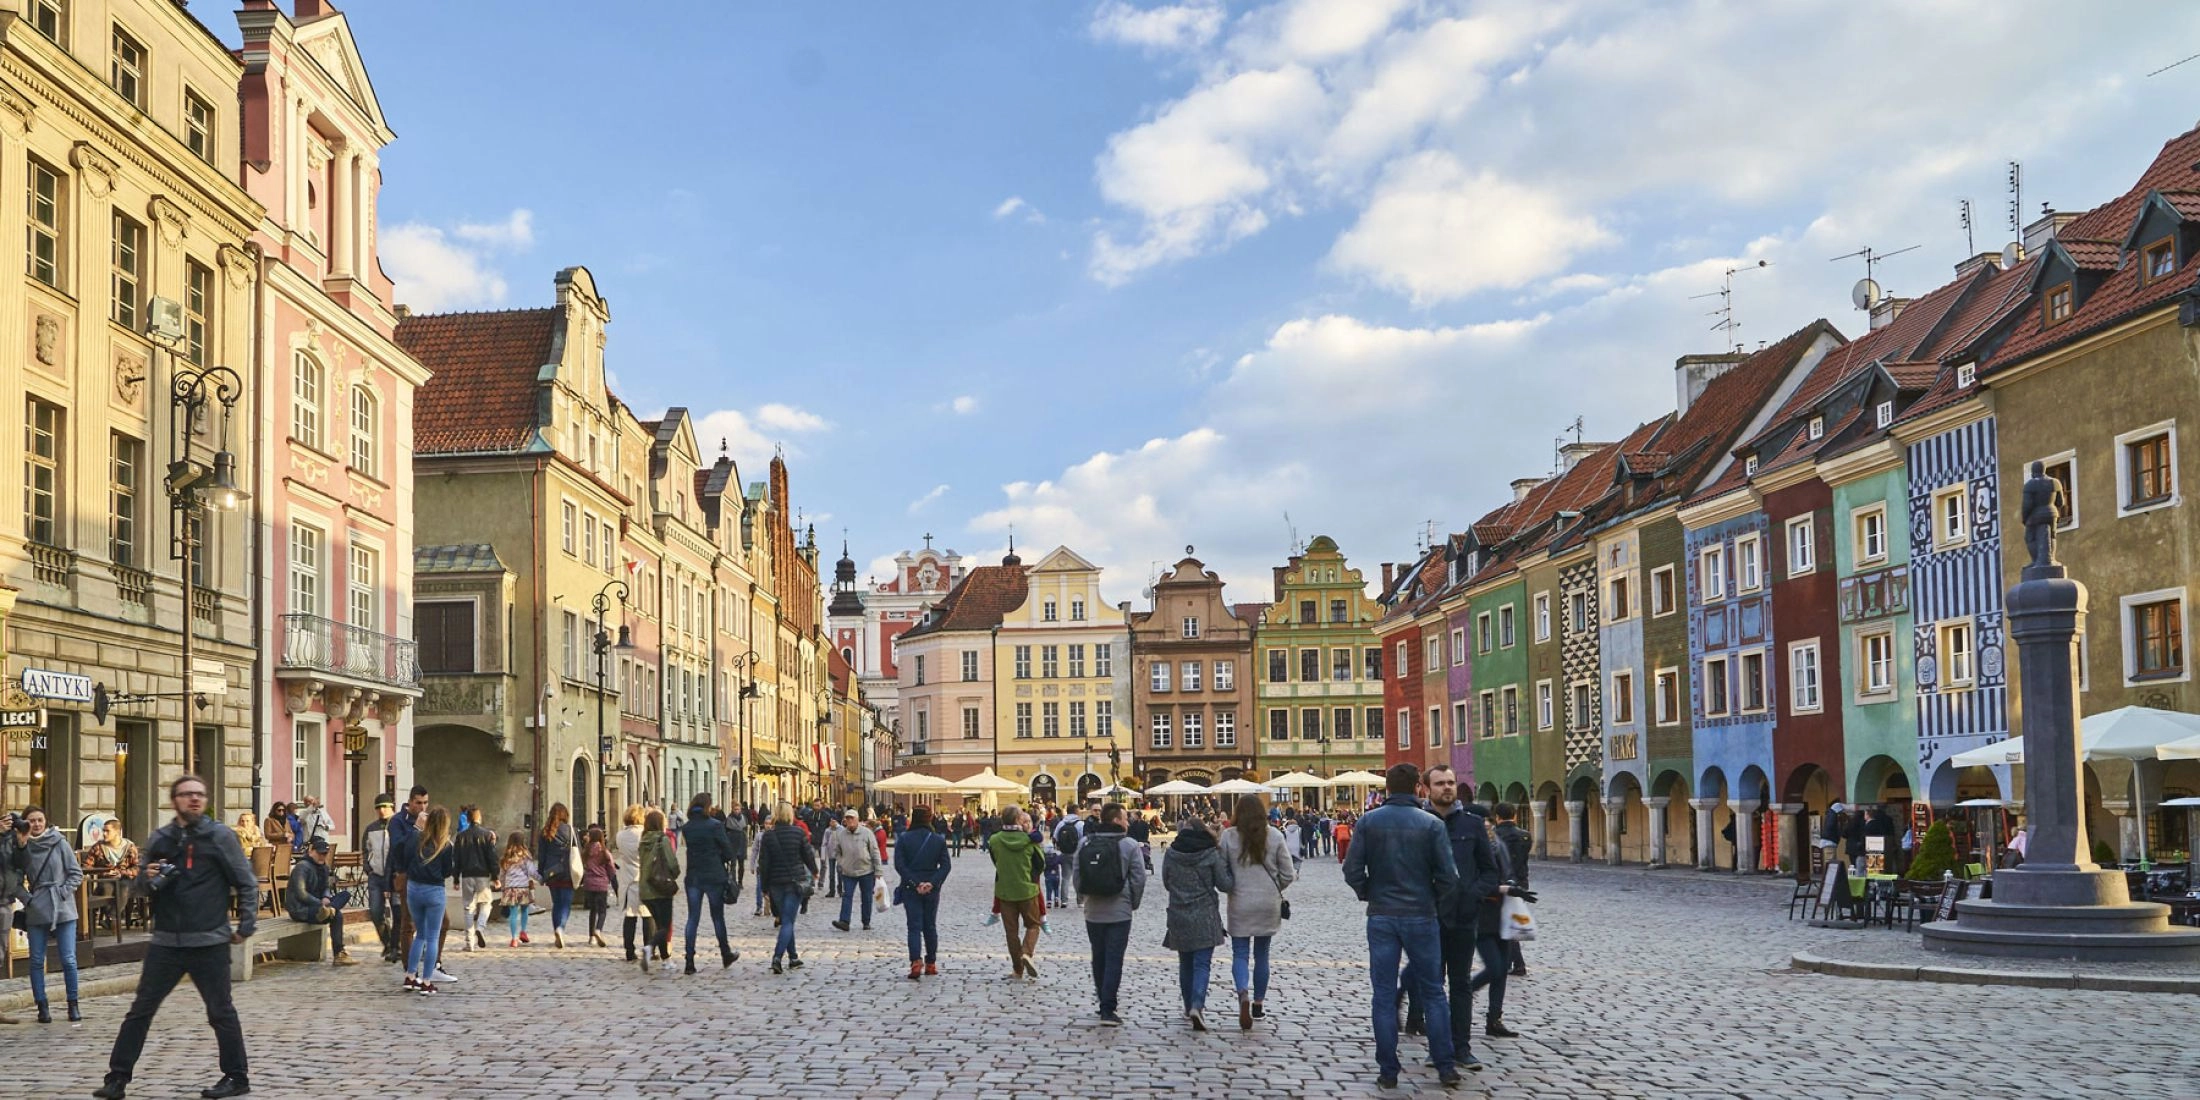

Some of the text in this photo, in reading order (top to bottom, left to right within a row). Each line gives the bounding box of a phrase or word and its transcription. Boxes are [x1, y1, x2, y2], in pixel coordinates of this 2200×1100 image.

[28, 673, 90, 698] ANTYKI
[2, 711, 36, 725] LECH
[9, 730, 31, 739] PILS
